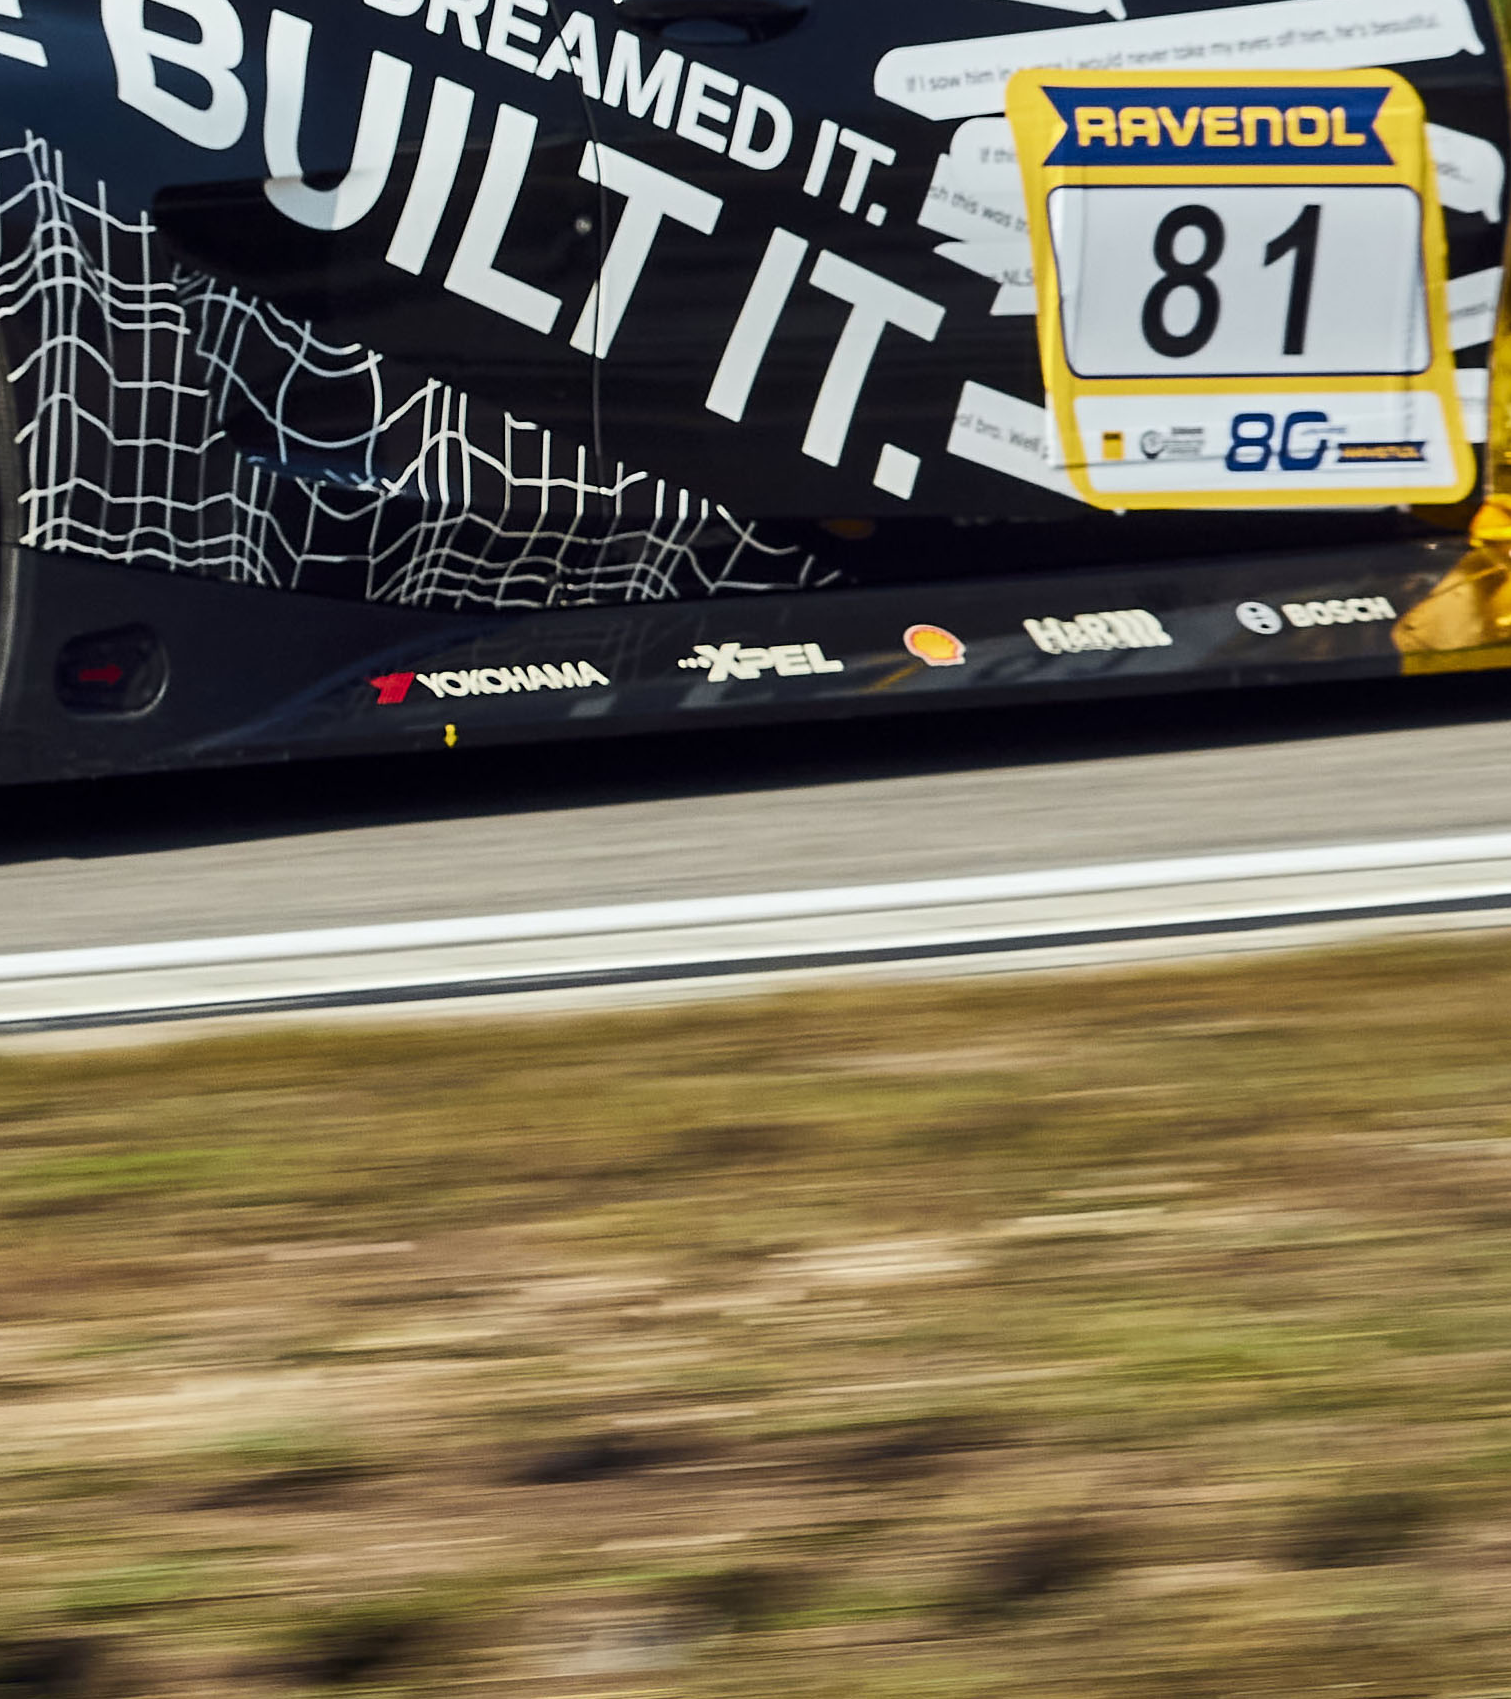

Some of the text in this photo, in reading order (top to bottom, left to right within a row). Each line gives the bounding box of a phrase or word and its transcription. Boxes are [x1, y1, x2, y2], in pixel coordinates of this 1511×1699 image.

[1127, 49, 1169, 65] never
[1173, 41, 1205, 60] take
[1210, 41, 1231, 58] my
[929, 76, 962, 92] saw
[965, 70, 995, 86] him
[1074, 106, 1367, 147] RAVENOL
[801, 119, 896, 226] IT.
[1141, 204, 1321, 358] 81
[705, 227, 948, 501] IT.
[1281, 596, 1397, 628] BOSCH
[415, 660, 611, 699] YOKOHAMA
[692, 642, 845, 683] XPEL
